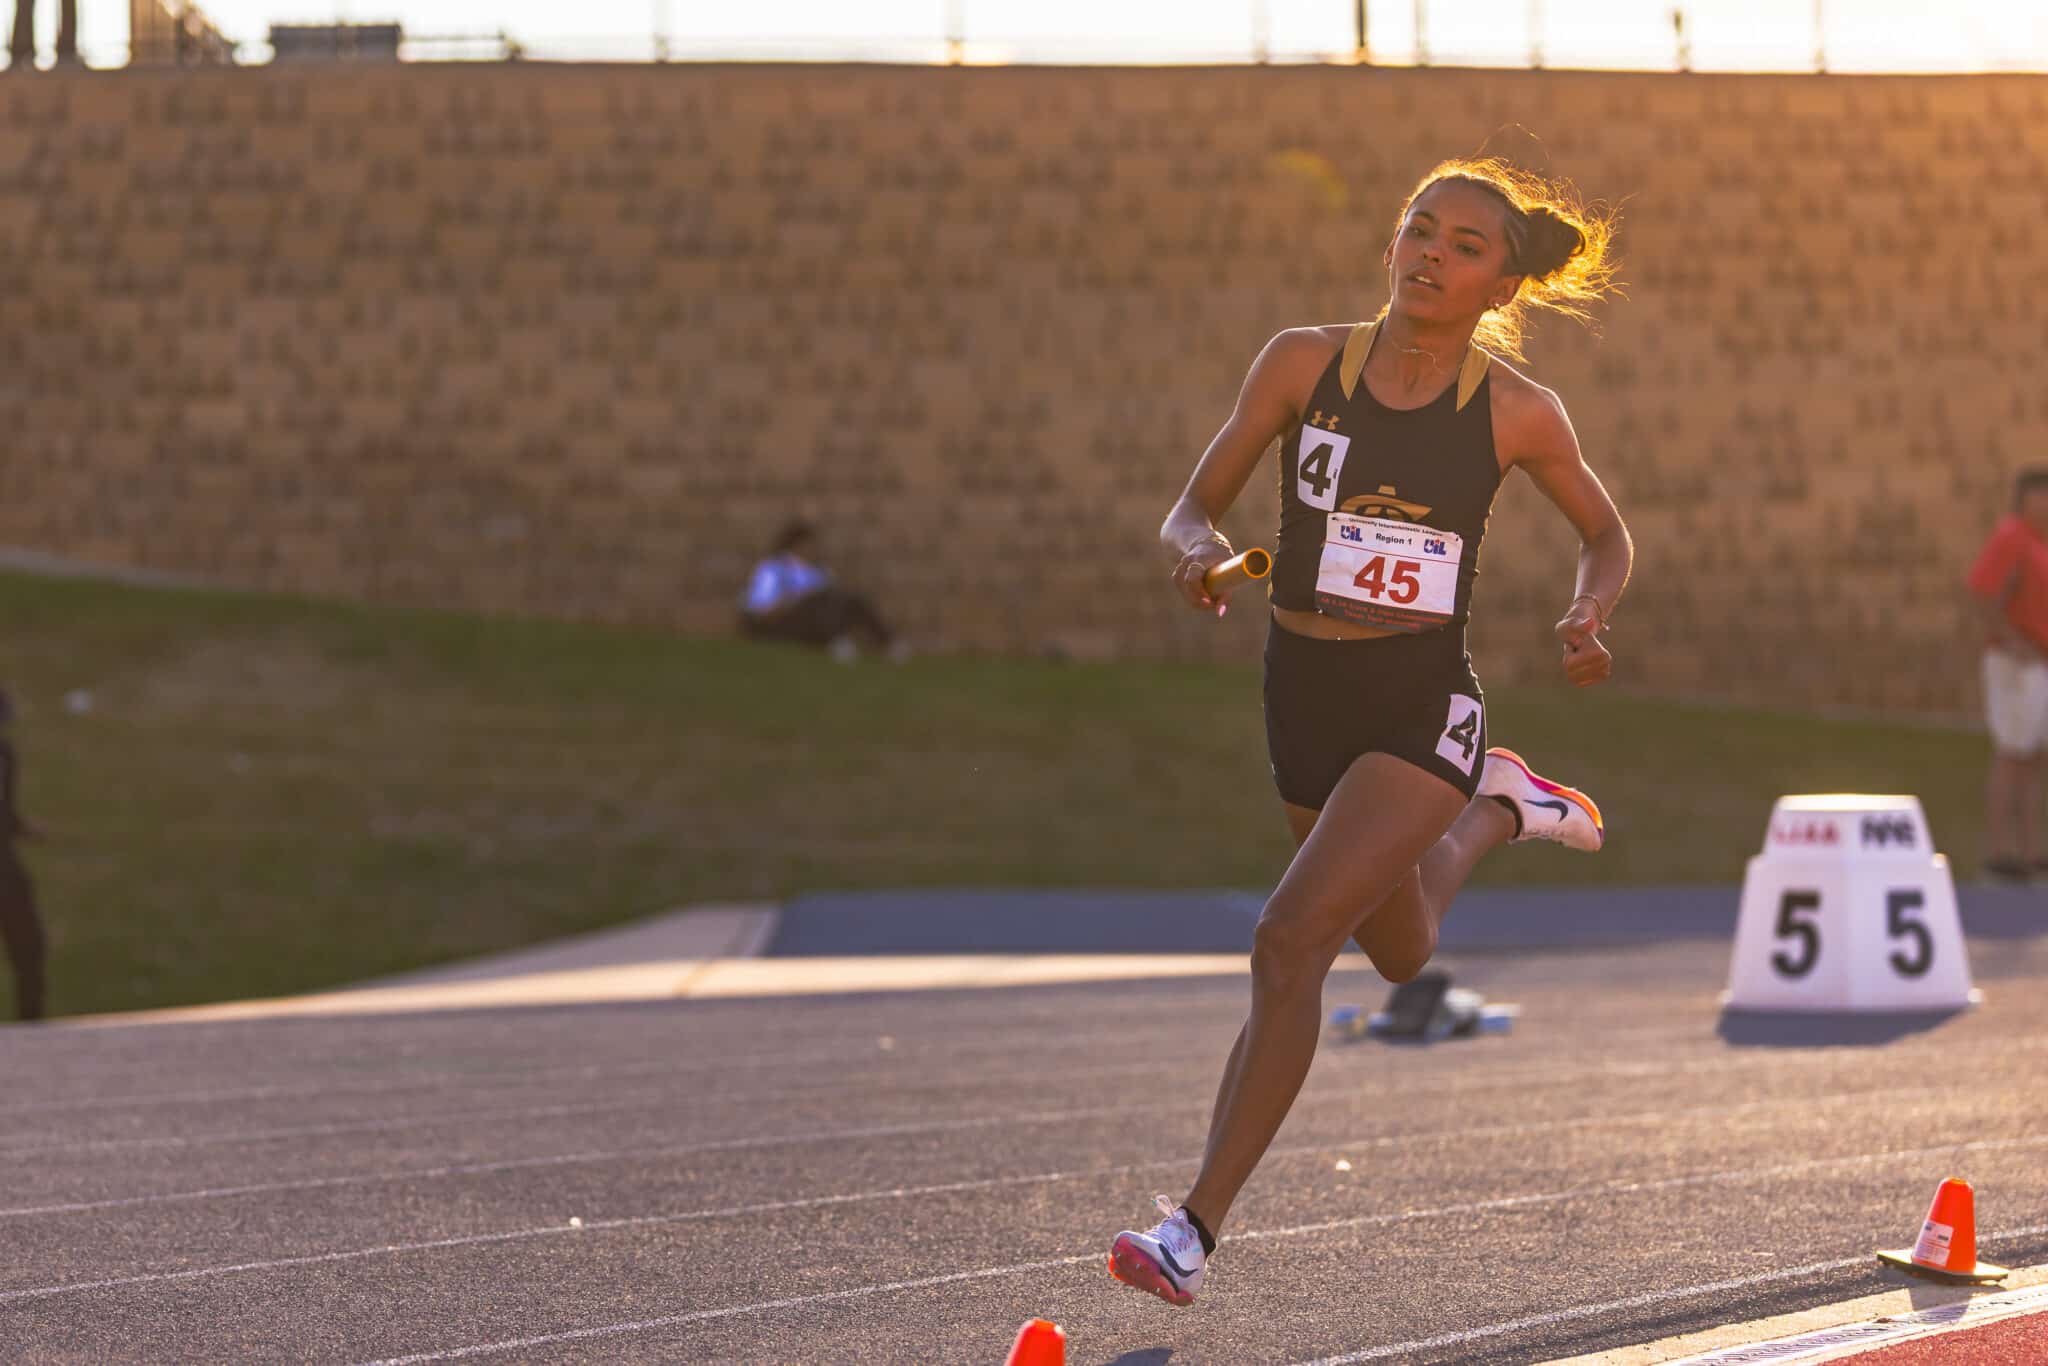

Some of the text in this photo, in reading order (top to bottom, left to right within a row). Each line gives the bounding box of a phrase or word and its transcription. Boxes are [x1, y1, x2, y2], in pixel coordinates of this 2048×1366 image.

[1300, 442, 1334, 498] 4
[1376, 532, 1405, 545] Region
[1353, 555, 1421, 604] 45
[1446, 709, 1477, 761] 4
[1770, 887, 1822, 982] 5
[1885, 887, 1935, 981] 5
